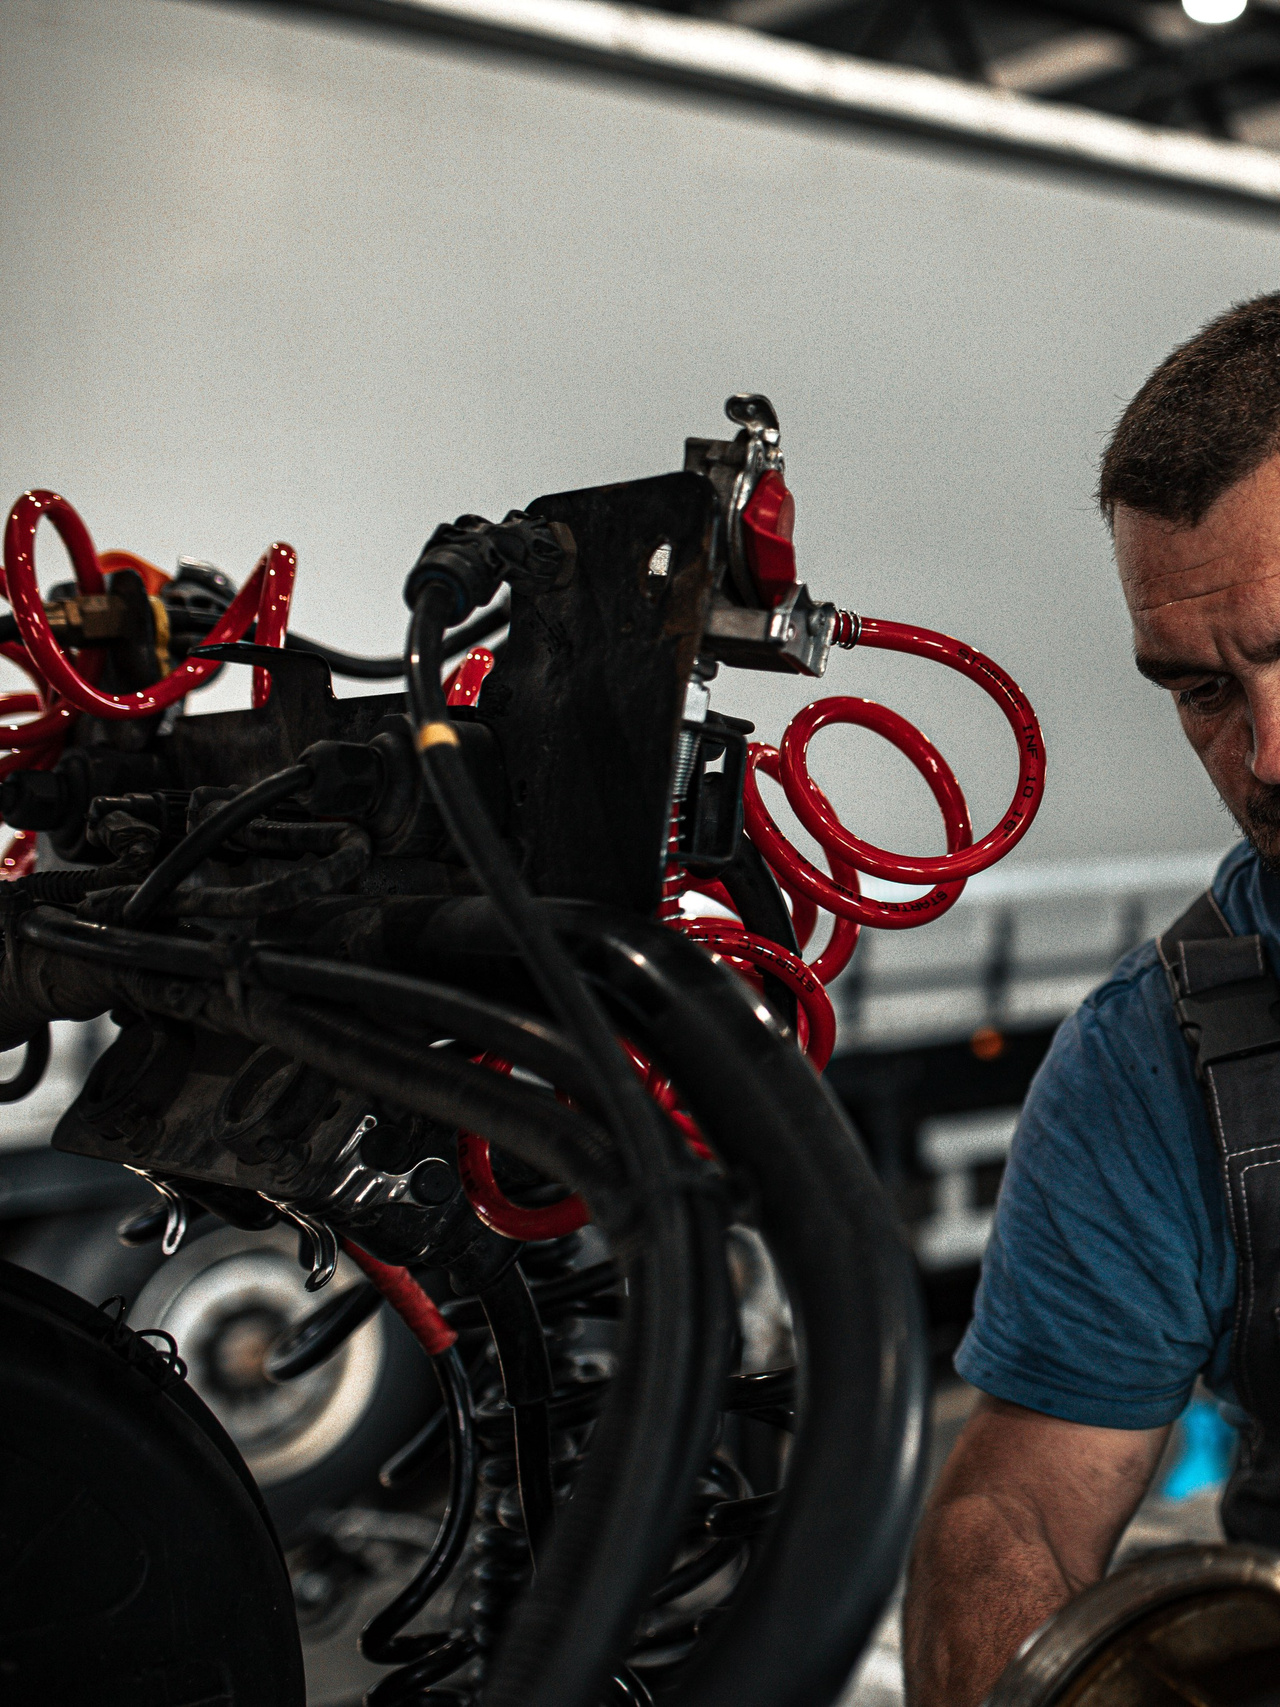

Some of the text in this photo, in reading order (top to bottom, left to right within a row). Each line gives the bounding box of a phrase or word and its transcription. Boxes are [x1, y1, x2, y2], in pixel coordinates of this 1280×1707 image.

[957, 648, 1024, 712] STARTEC
[878, 890, 948, 913] STARTEC
[738, 938, 816, 993] STARTEC
